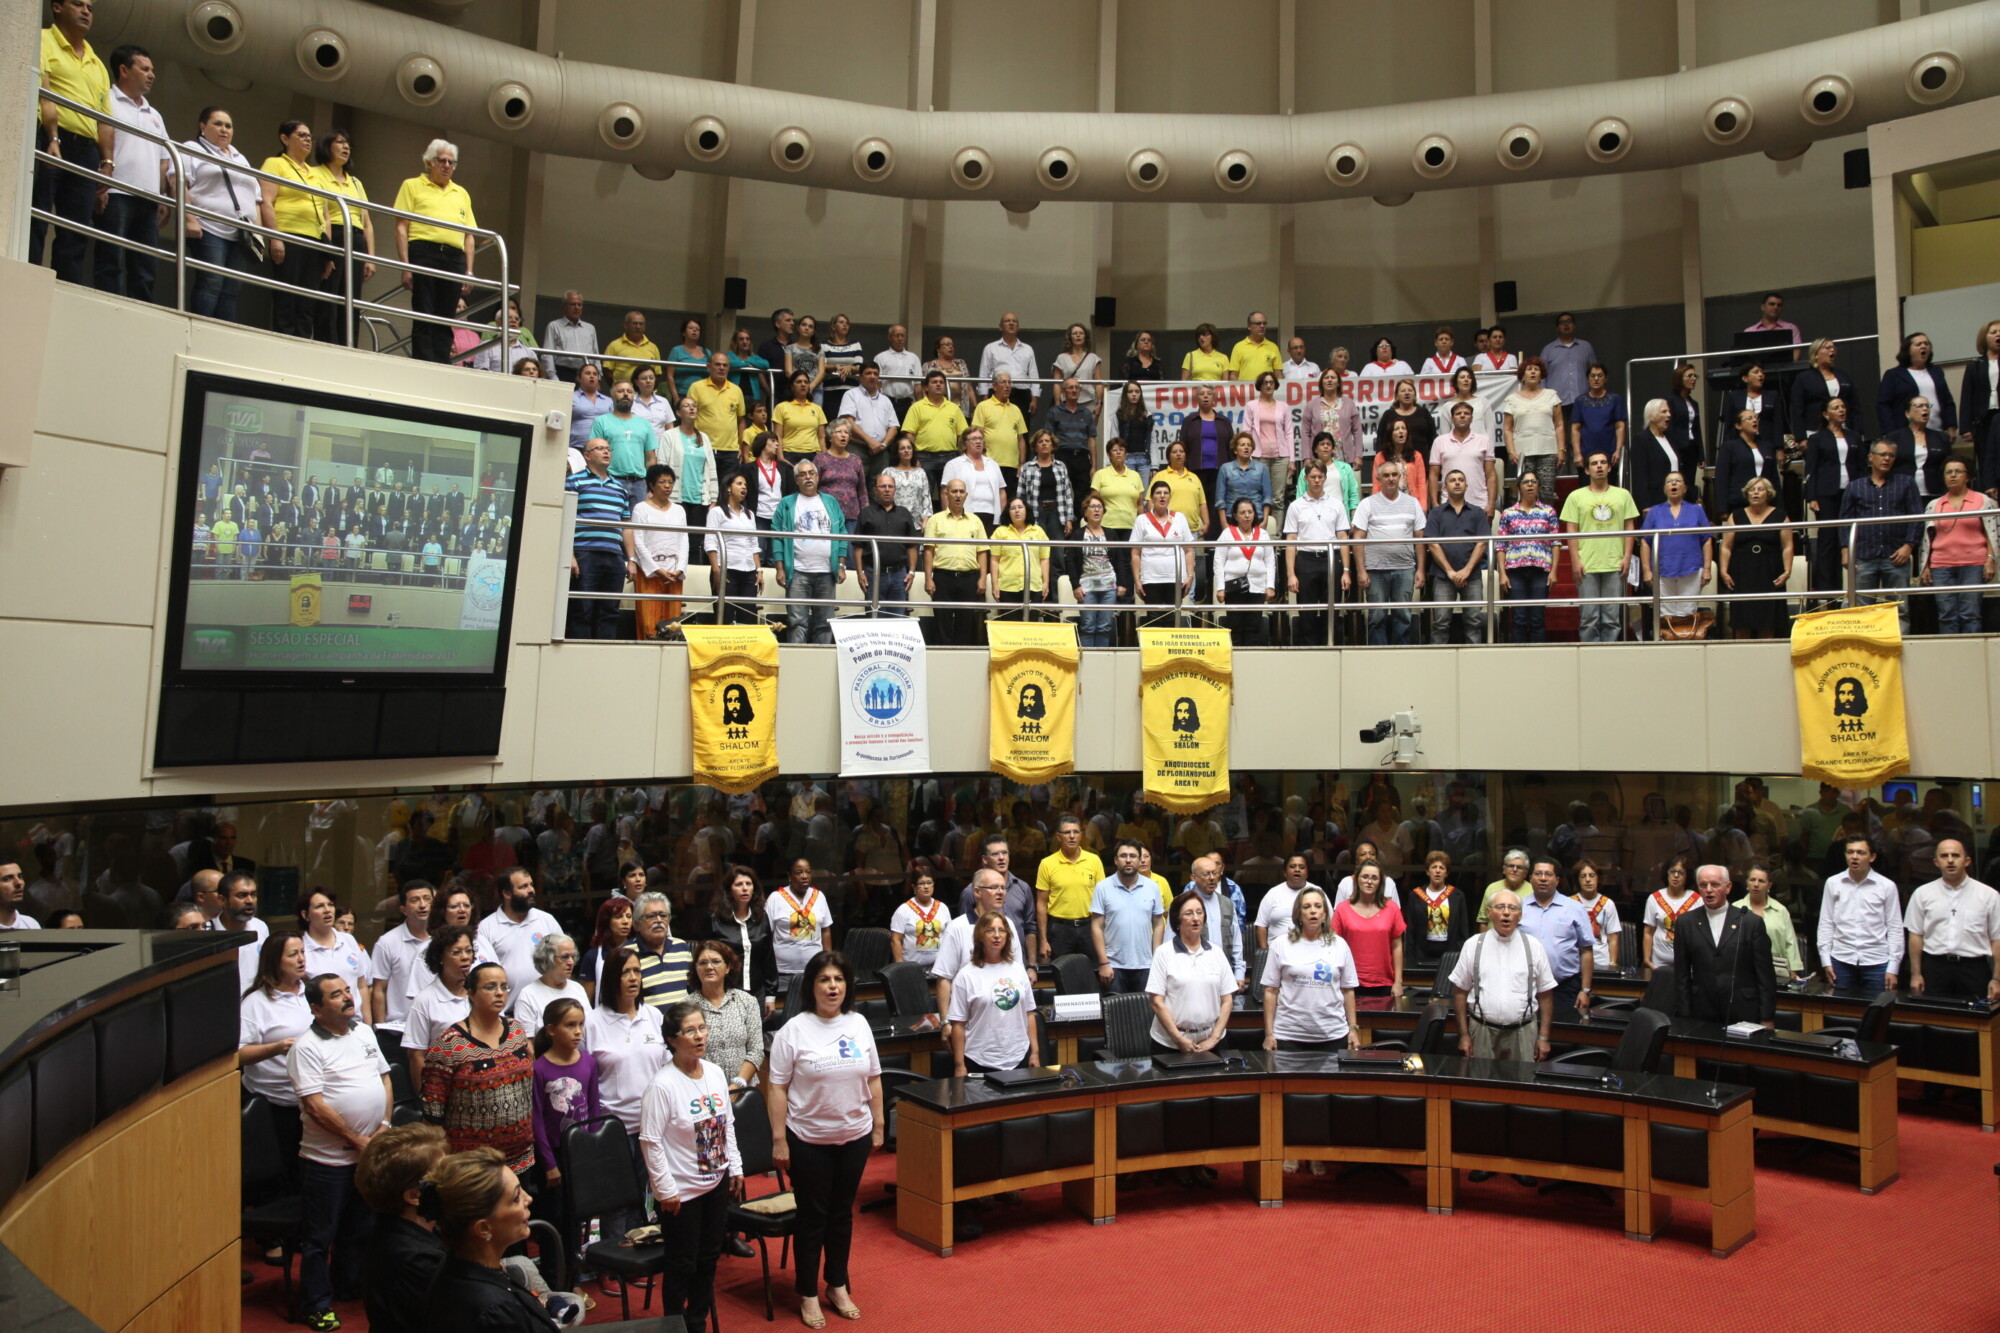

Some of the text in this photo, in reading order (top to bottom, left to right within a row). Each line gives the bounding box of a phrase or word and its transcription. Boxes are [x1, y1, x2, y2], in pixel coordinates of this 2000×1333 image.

[250, 630, 361, 646] SESSÃO ESPECIAL
[853, 651, 872, 664] Ponte
[885, 649, 912, 662] Imaruim
[1168, 648, 1193, 656] BIGUAÇU
[854, 664, 912, 691] PASTORAL FAMILIAR
[1007, 669, 1034, 695] MOVIMENTO
[1044, 674, 1057, 698] IRMÃOS
[1150, 671, 1188, 691] MOVIMENTO
[1818, 663, 1848, 693] MOVIMENTO
[1862, 666, 1880, 689] IRMÃOS
[710, 672, 736, 704] MOVIMENTO
[868, 716, 900, 726] BRASIL
[1012, 734, 1049, 743] SHALOM
[1830, 732, 1876, 743] SHALOM
[720, 741, 759, 751] SHALOM
[690, 1093, 723, 1114] SOS
